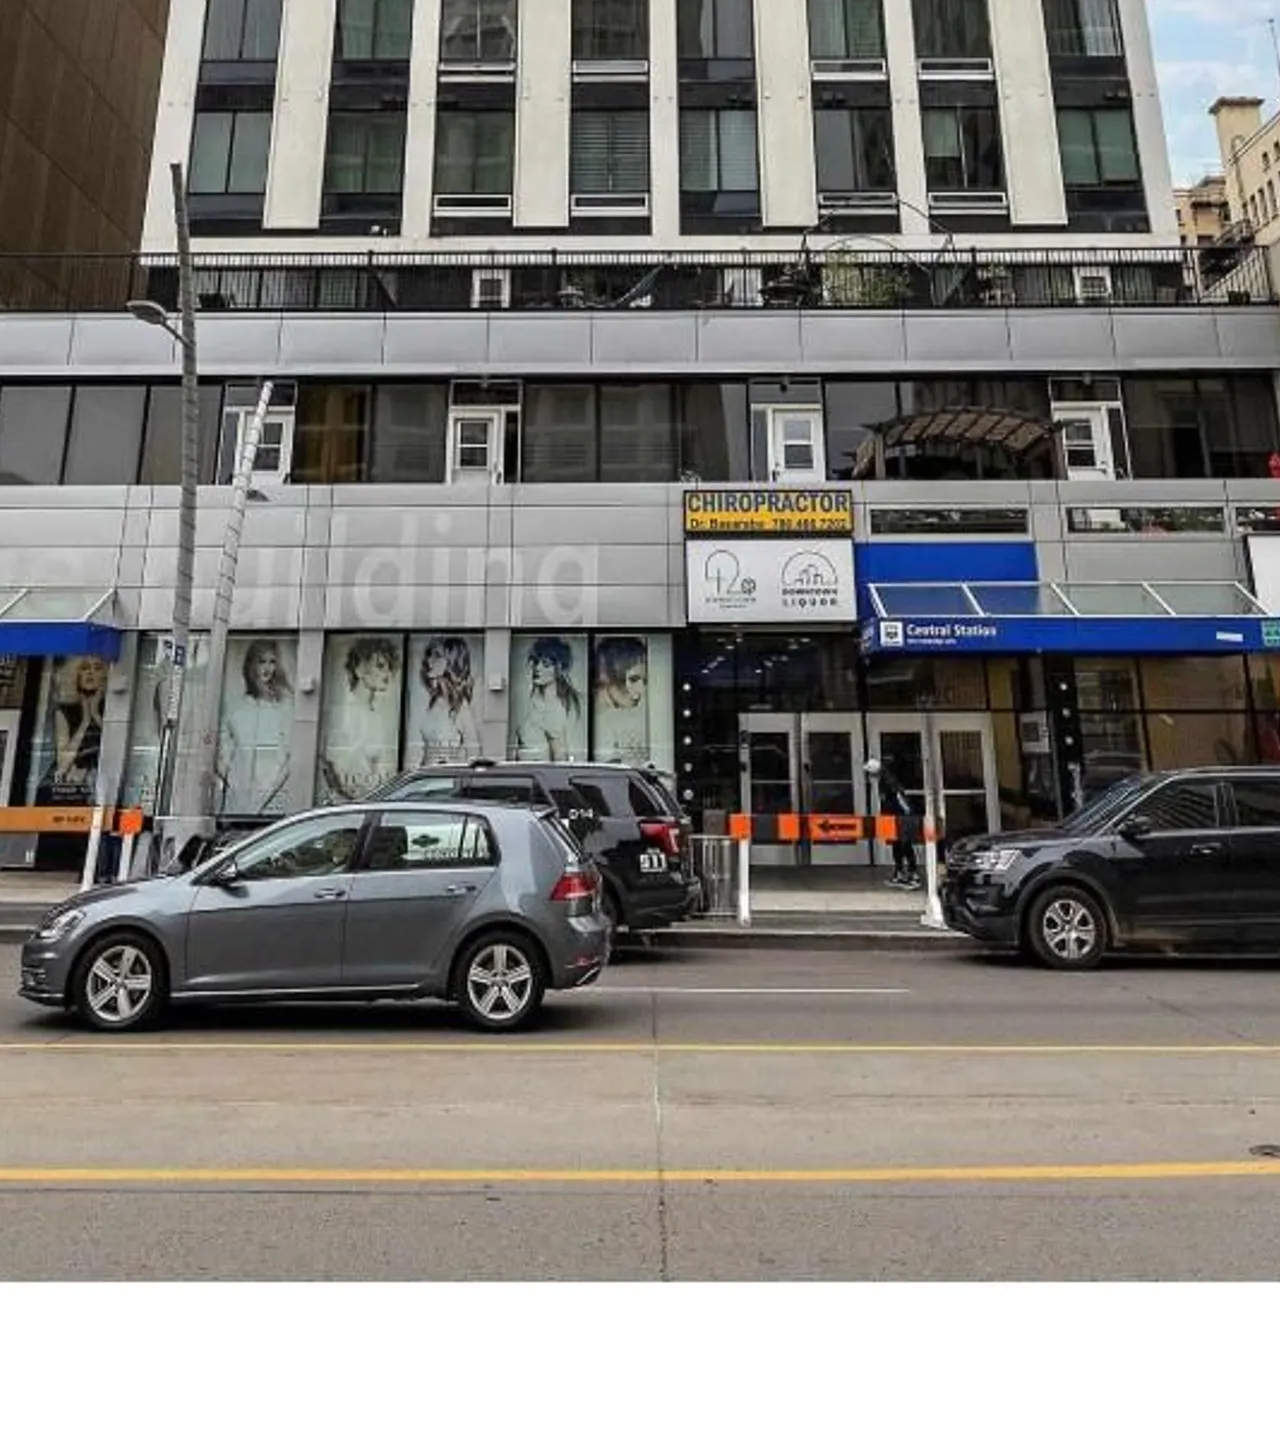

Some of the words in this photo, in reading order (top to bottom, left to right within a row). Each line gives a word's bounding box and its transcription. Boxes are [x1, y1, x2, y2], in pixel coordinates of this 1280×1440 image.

[687, 494, 849, 512] CHIROPRACTOR
[906, 623, 951, 637] Central
[953, 623, 997, 638] Station
